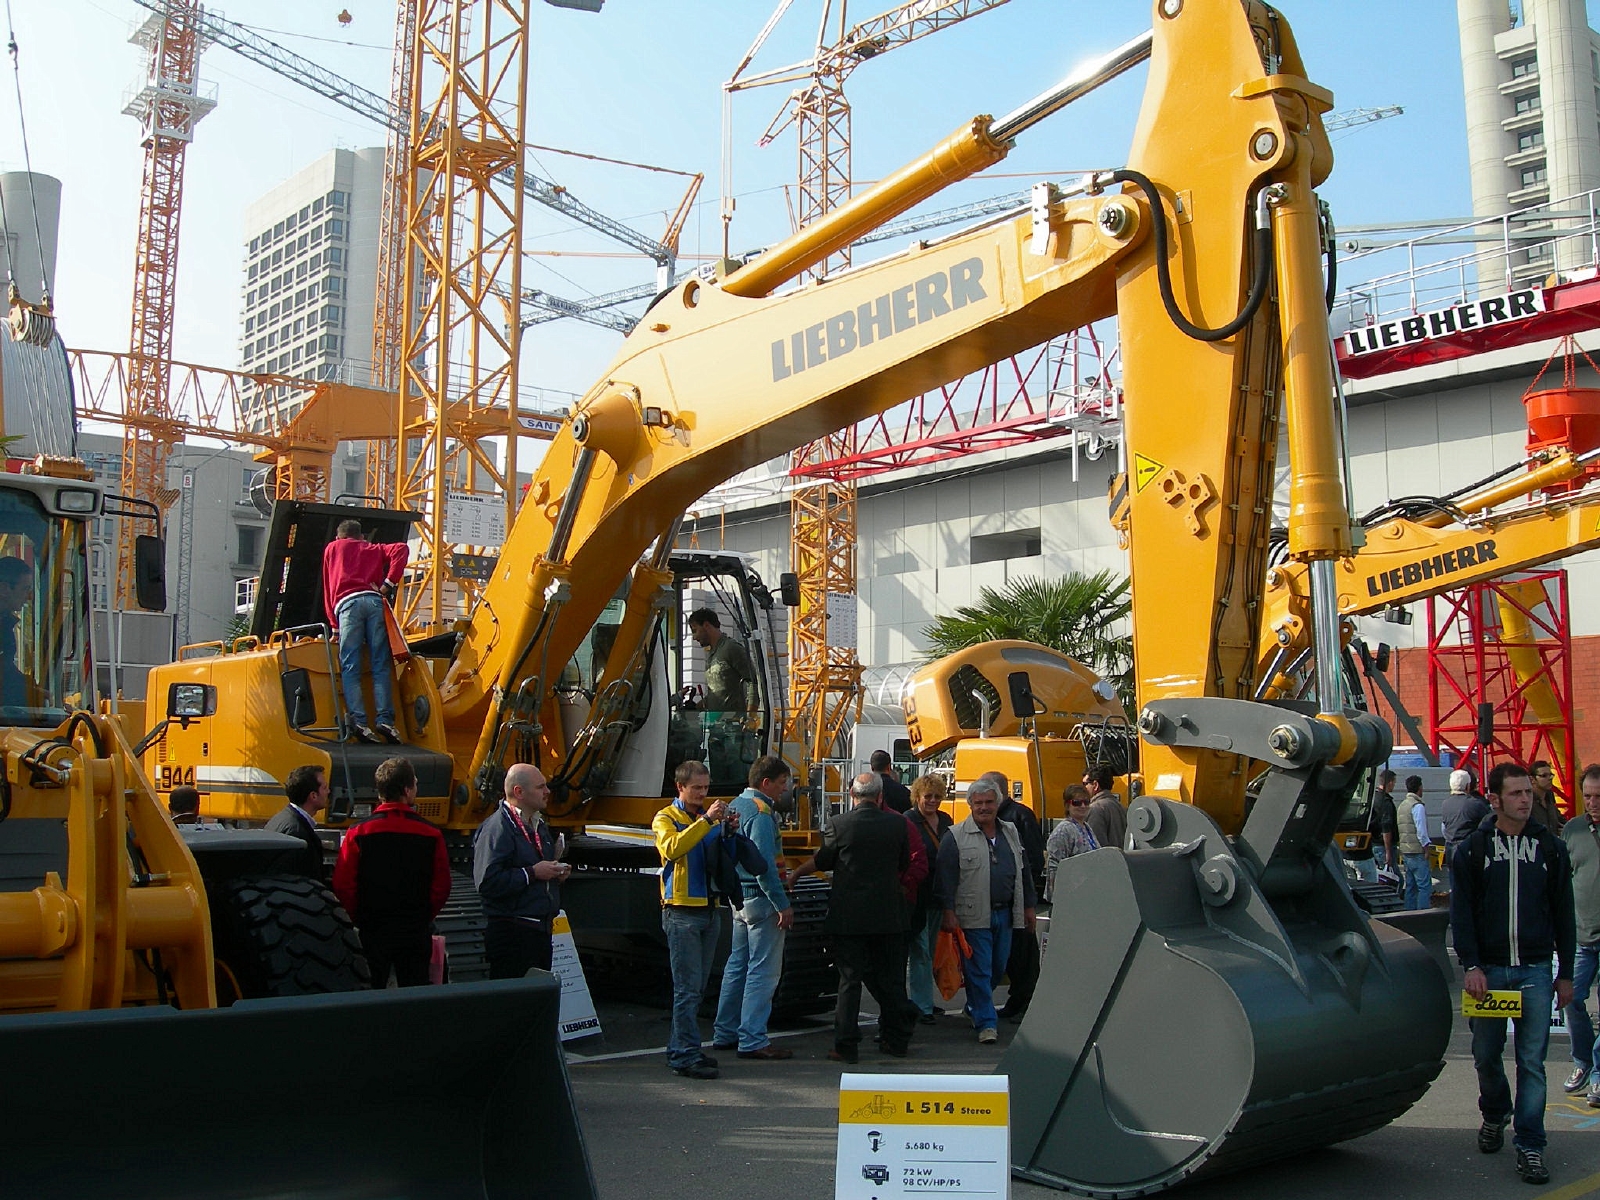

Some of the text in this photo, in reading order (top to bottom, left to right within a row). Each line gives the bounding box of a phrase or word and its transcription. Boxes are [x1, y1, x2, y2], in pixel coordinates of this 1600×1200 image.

[771, 257, 988, 382] LIEBHERR
[1350, 290, 1538, 353] LIEBHERR
[527, 419, 553, 430] SAN
[1367, 539, 1499, 597] LIEBHERR
[162, 765, 196, 788] 944
[1475, 993, 1520, 1010] Leca
[906, 1101, 992, 1115] L 514 Stereo
[905, 1142, 944, 1152] 5.680 kg
[903, 1167, 933, 1176] 72 kW
[902, 1177, 961, 1187] 98 CV/HP/PS
